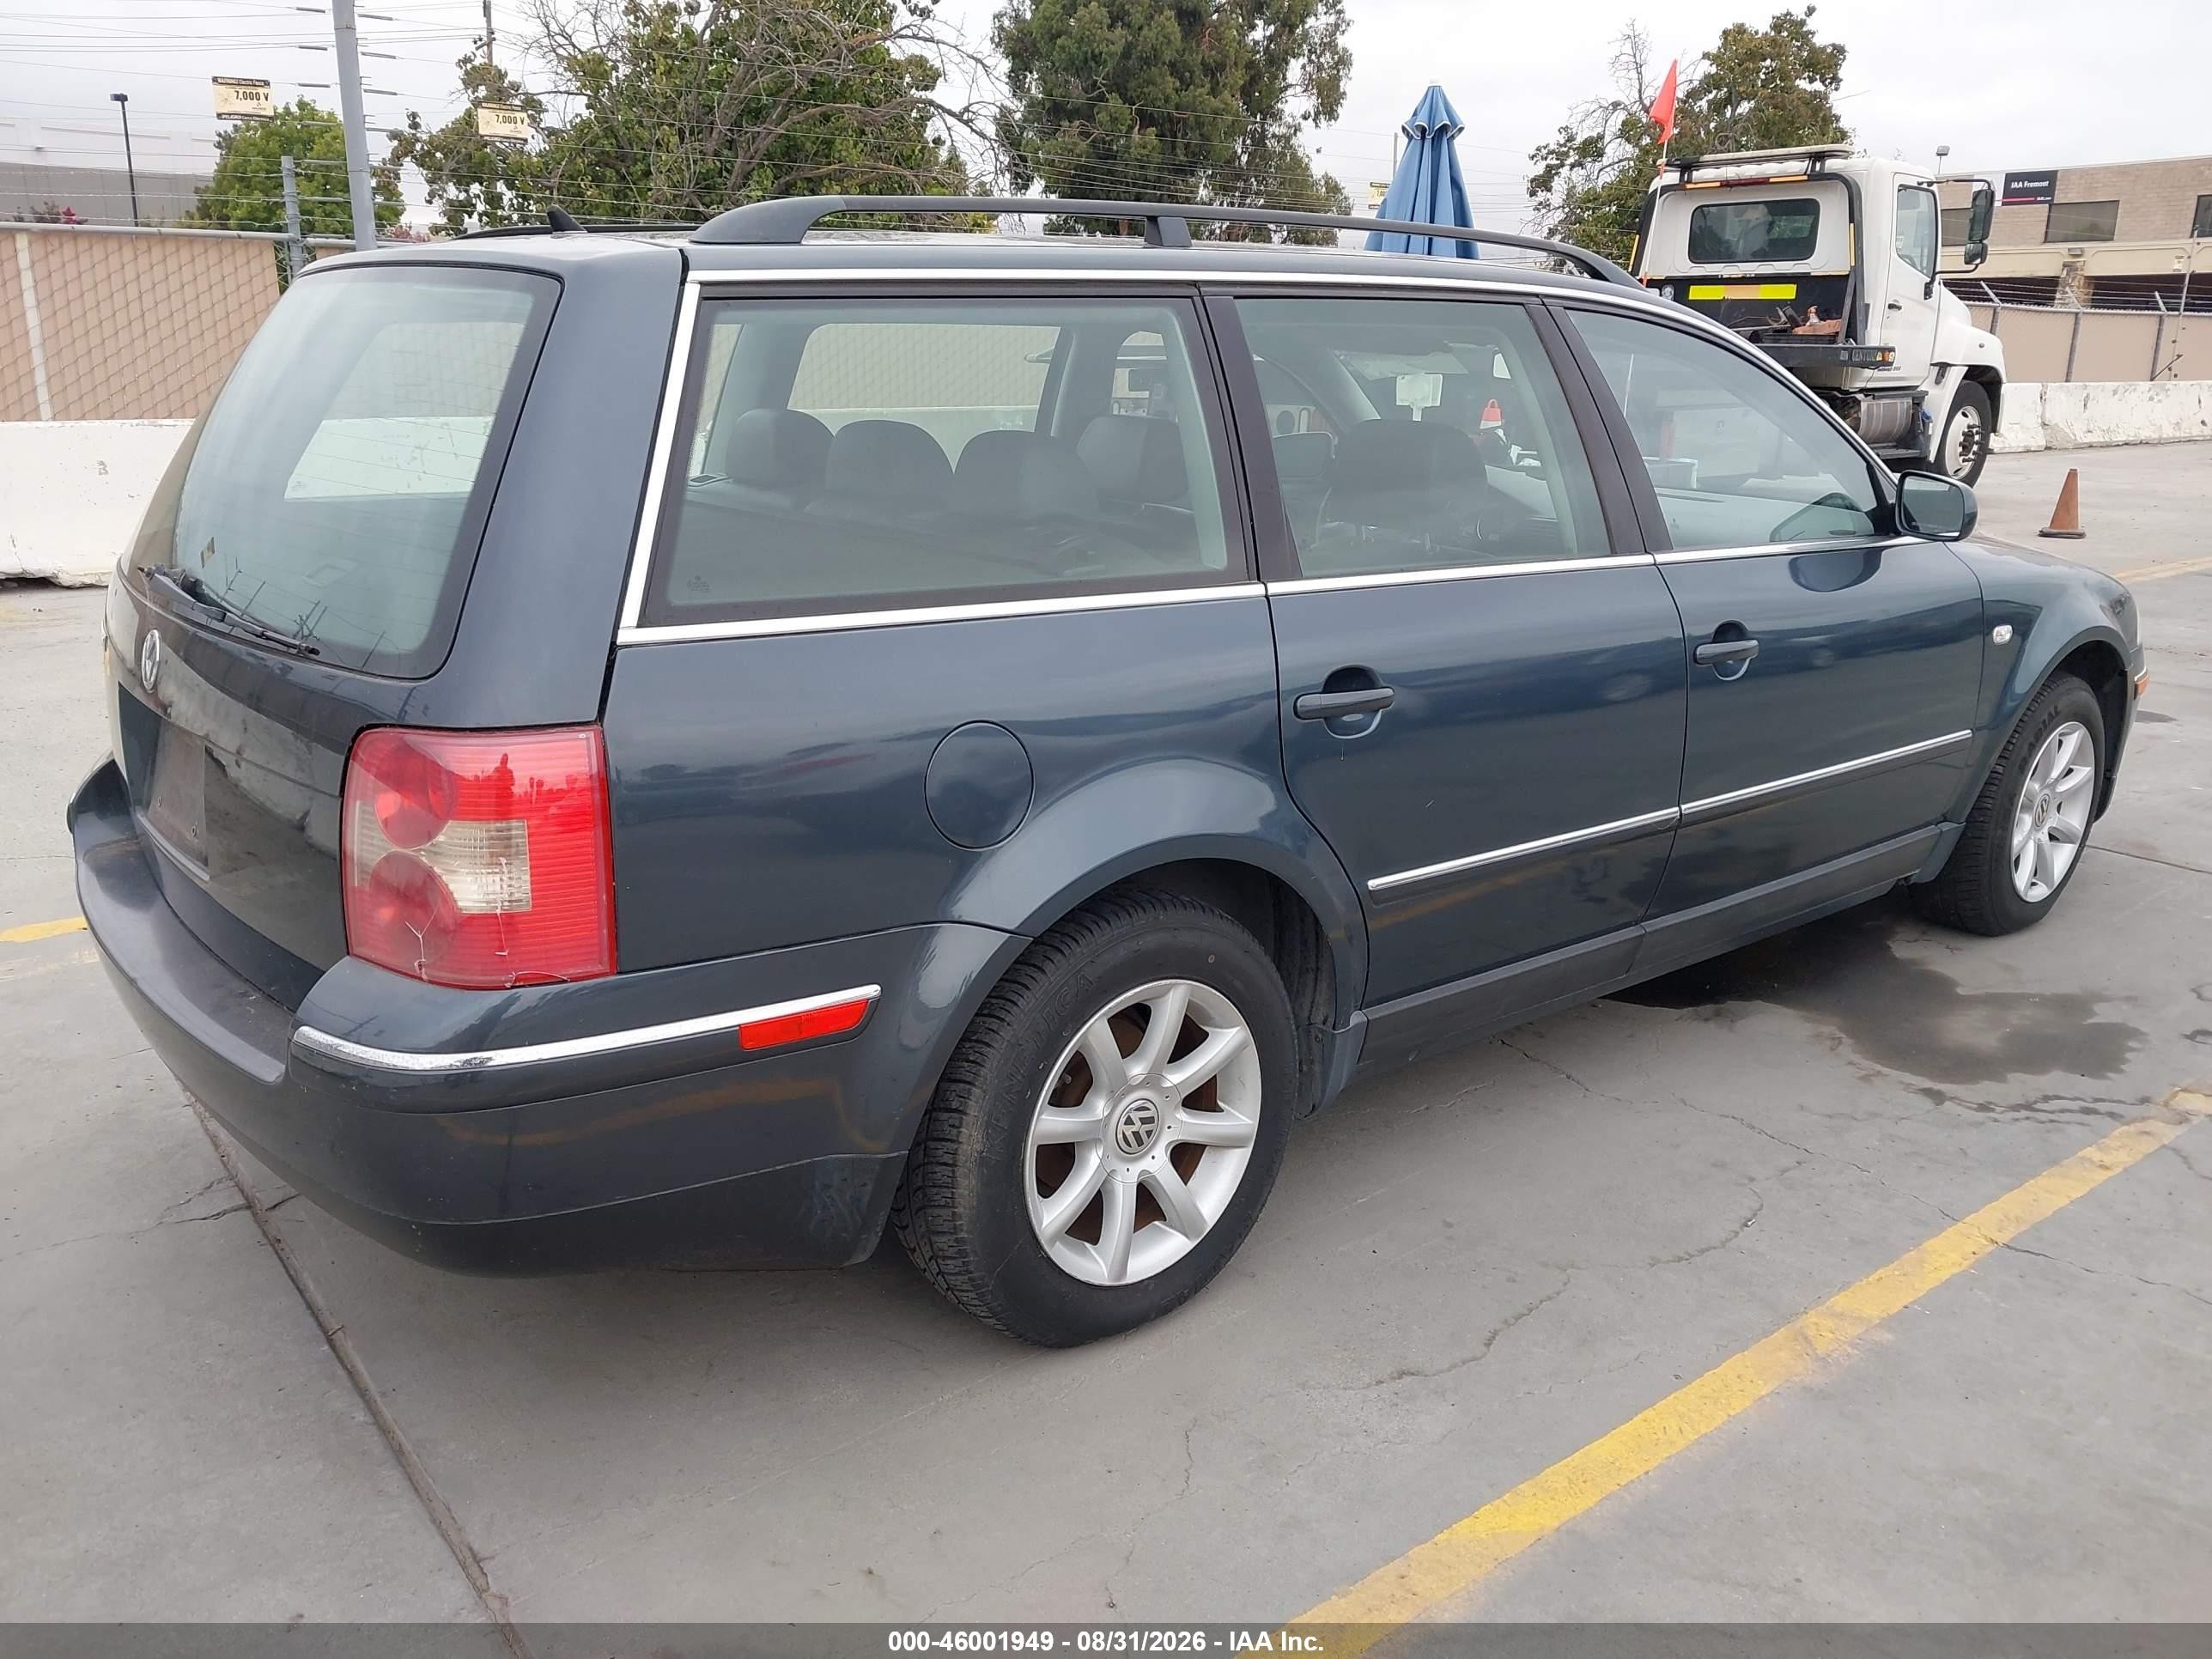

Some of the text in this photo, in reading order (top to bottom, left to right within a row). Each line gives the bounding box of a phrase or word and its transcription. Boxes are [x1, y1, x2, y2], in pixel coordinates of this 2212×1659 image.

[234, 89, 269, 101] 7,000 V
[495, 114, 526, 125] 7,000 V
[2011, 180, 2023, 189] IAA
